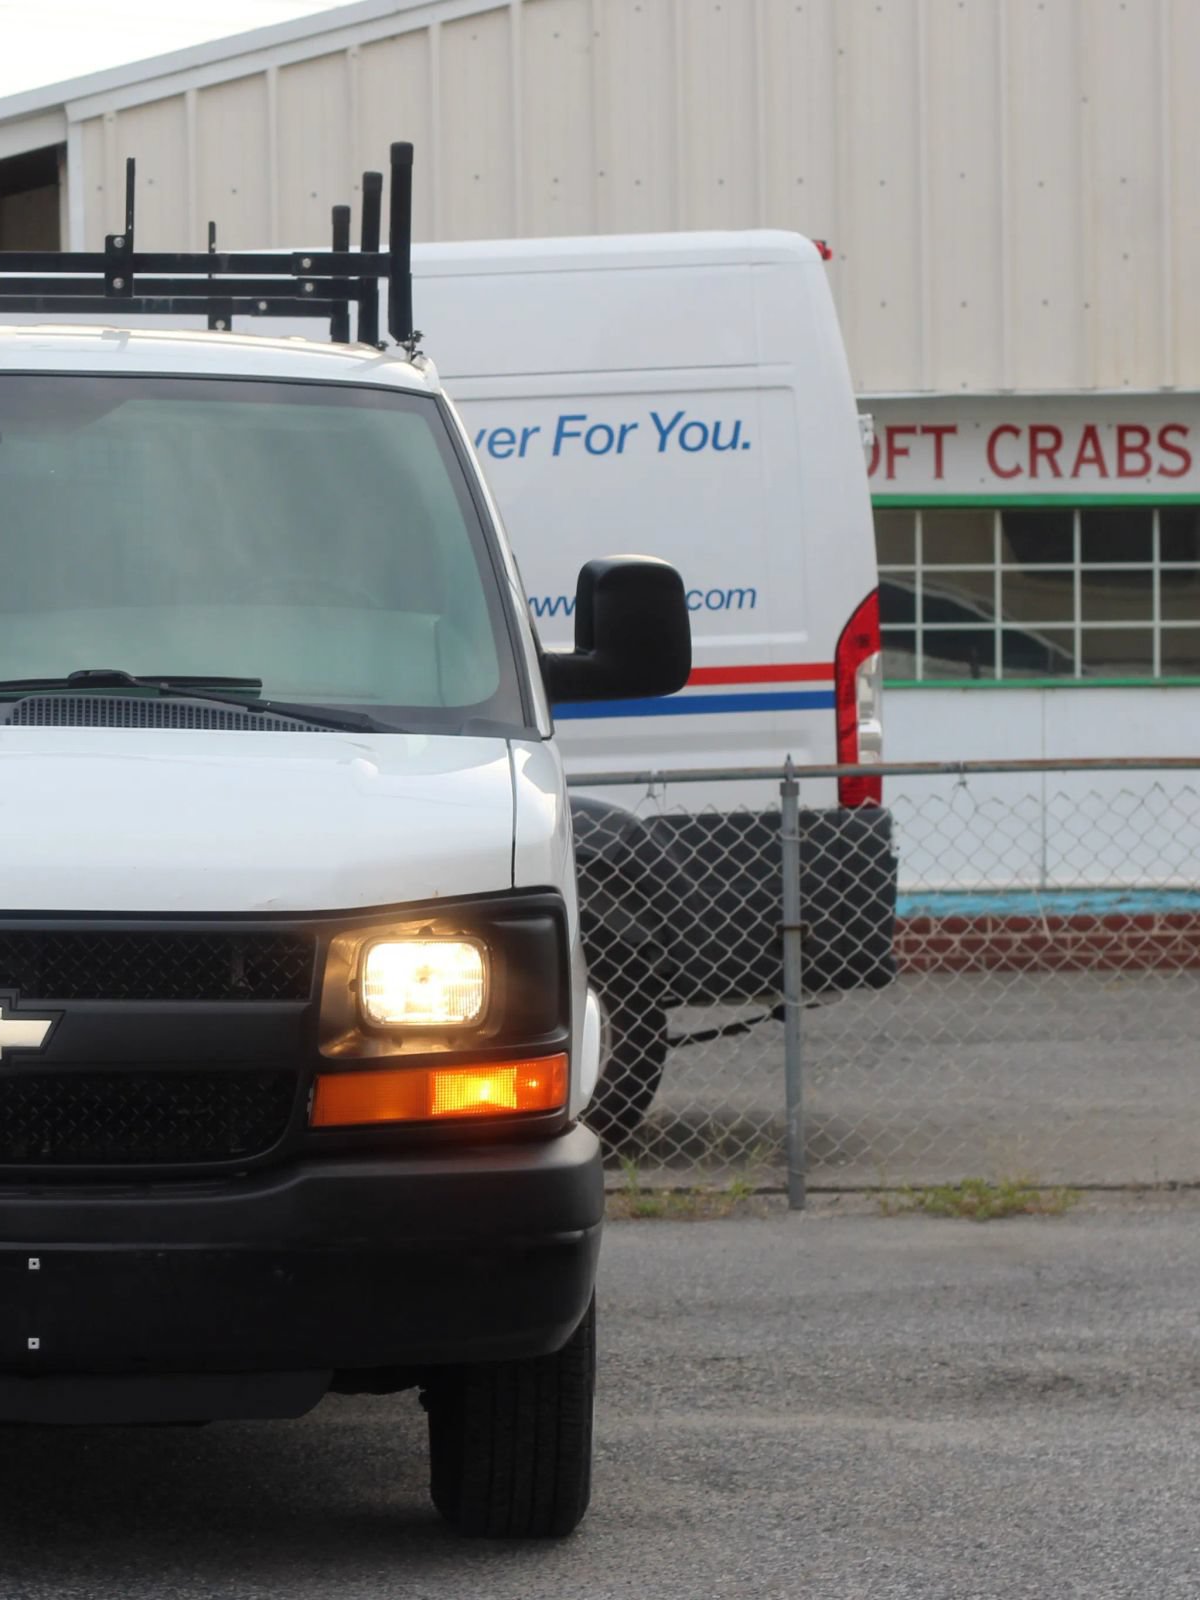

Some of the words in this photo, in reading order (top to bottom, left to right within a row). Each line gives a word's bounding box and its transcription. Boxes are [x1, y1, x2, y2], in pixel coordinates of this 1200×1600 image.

[552, 414, 639, 457] For
[649, 411, 751, 453] You.
[986, 423, 1193, 480] CRABS
